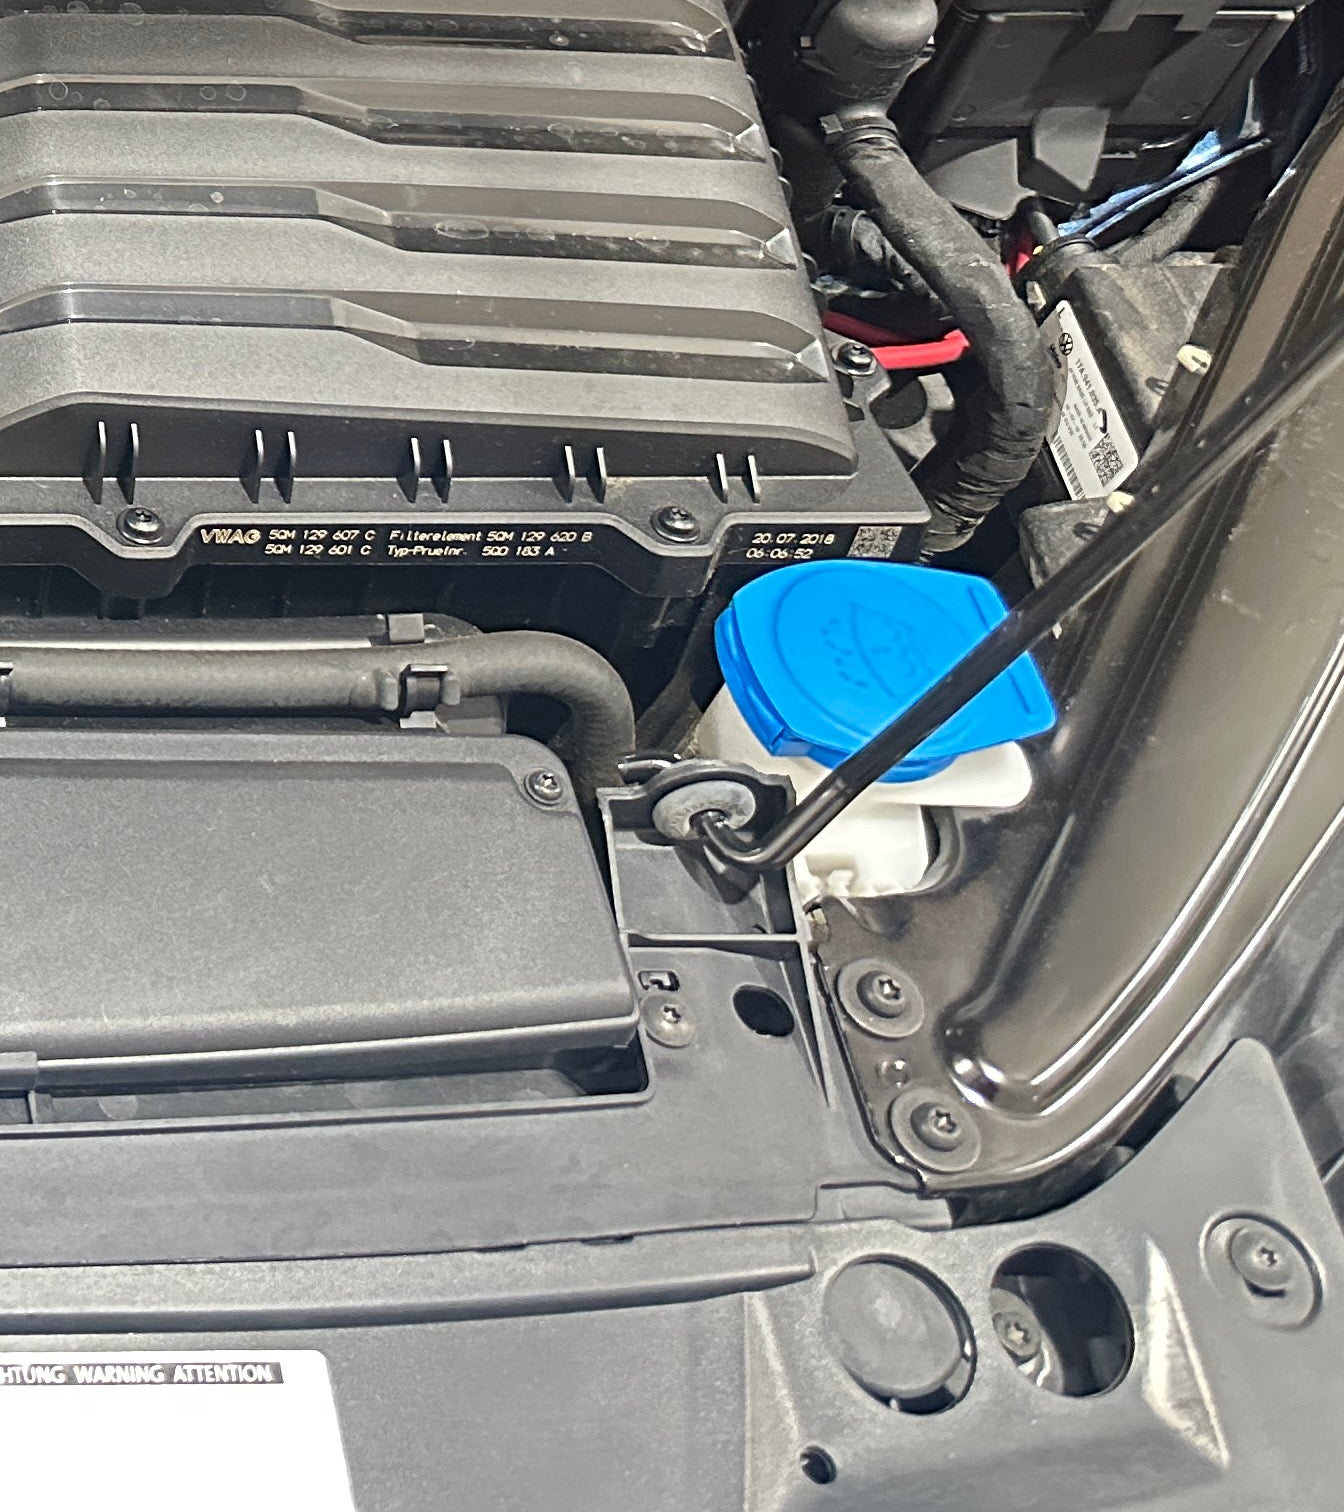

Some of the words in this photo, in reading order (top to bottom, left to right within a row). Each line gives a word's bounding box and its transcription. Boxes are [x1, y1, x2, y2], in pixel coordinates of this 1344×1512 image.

[303, 529, 327, 541] 129
[332, 529, 360, 541] 607
[365, 529, 377, 541] C
[389, 529, 483, 542] Filterelement
[521, 530, 545, 542] 129
[551, 530, 577, 542] 620
[581, 530, 593, 543] B
[299, 544, 323, 556] 129
[327, 544, 354, 556] 601
[360, 545, 372, 556] C
[516, 545, 541, 557] 183
[544, 545, 555, 557] A
[72, 1364, 165, 1384] WARNING
[172, 1362, 274, 1384] ATTENTION
